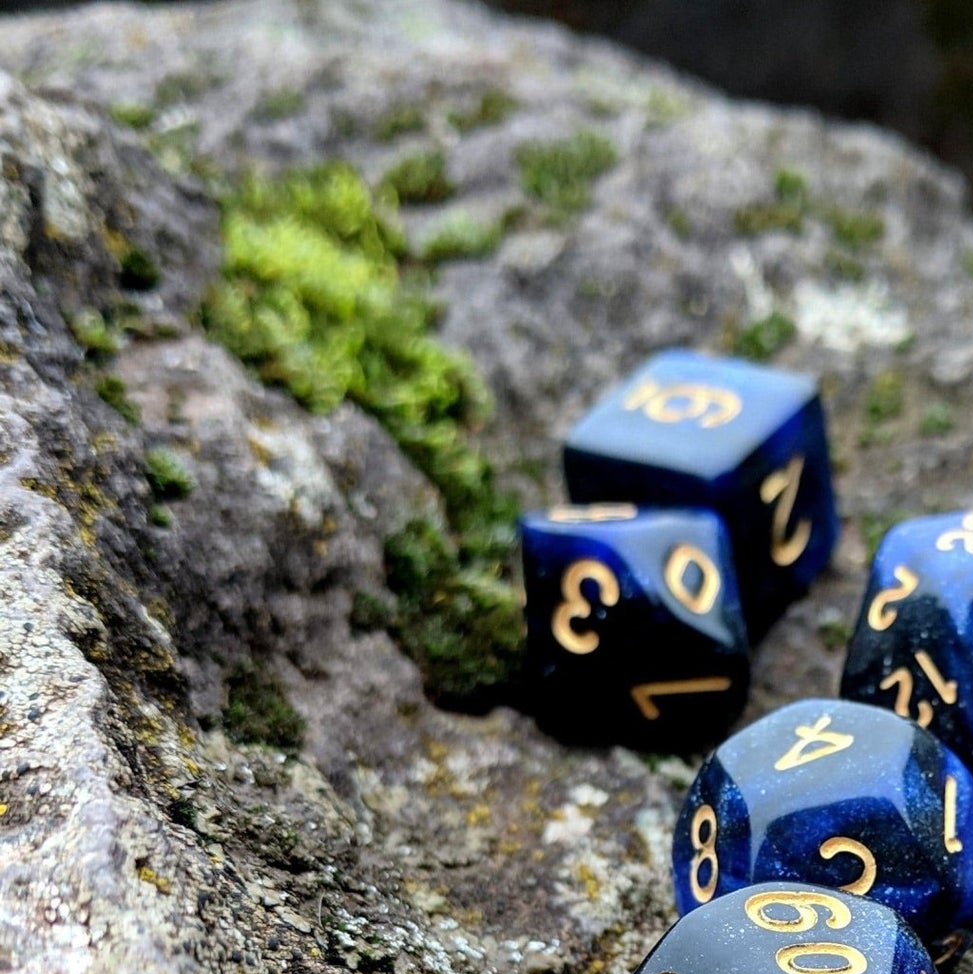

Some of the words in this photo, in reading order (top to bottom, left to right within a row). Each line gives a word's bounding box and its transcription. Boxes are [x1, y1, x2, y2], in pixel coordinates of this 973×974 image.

[760, 455, 812, 566] 2
[551, 558, 620, 655] 3
[663, 542, 721, 615] 0
[867, 564, 919, 631] 2
[773, 715, 855, 771] 4
[943, 774, 964, 853] 1
[689, 804, 719, 903] 8
